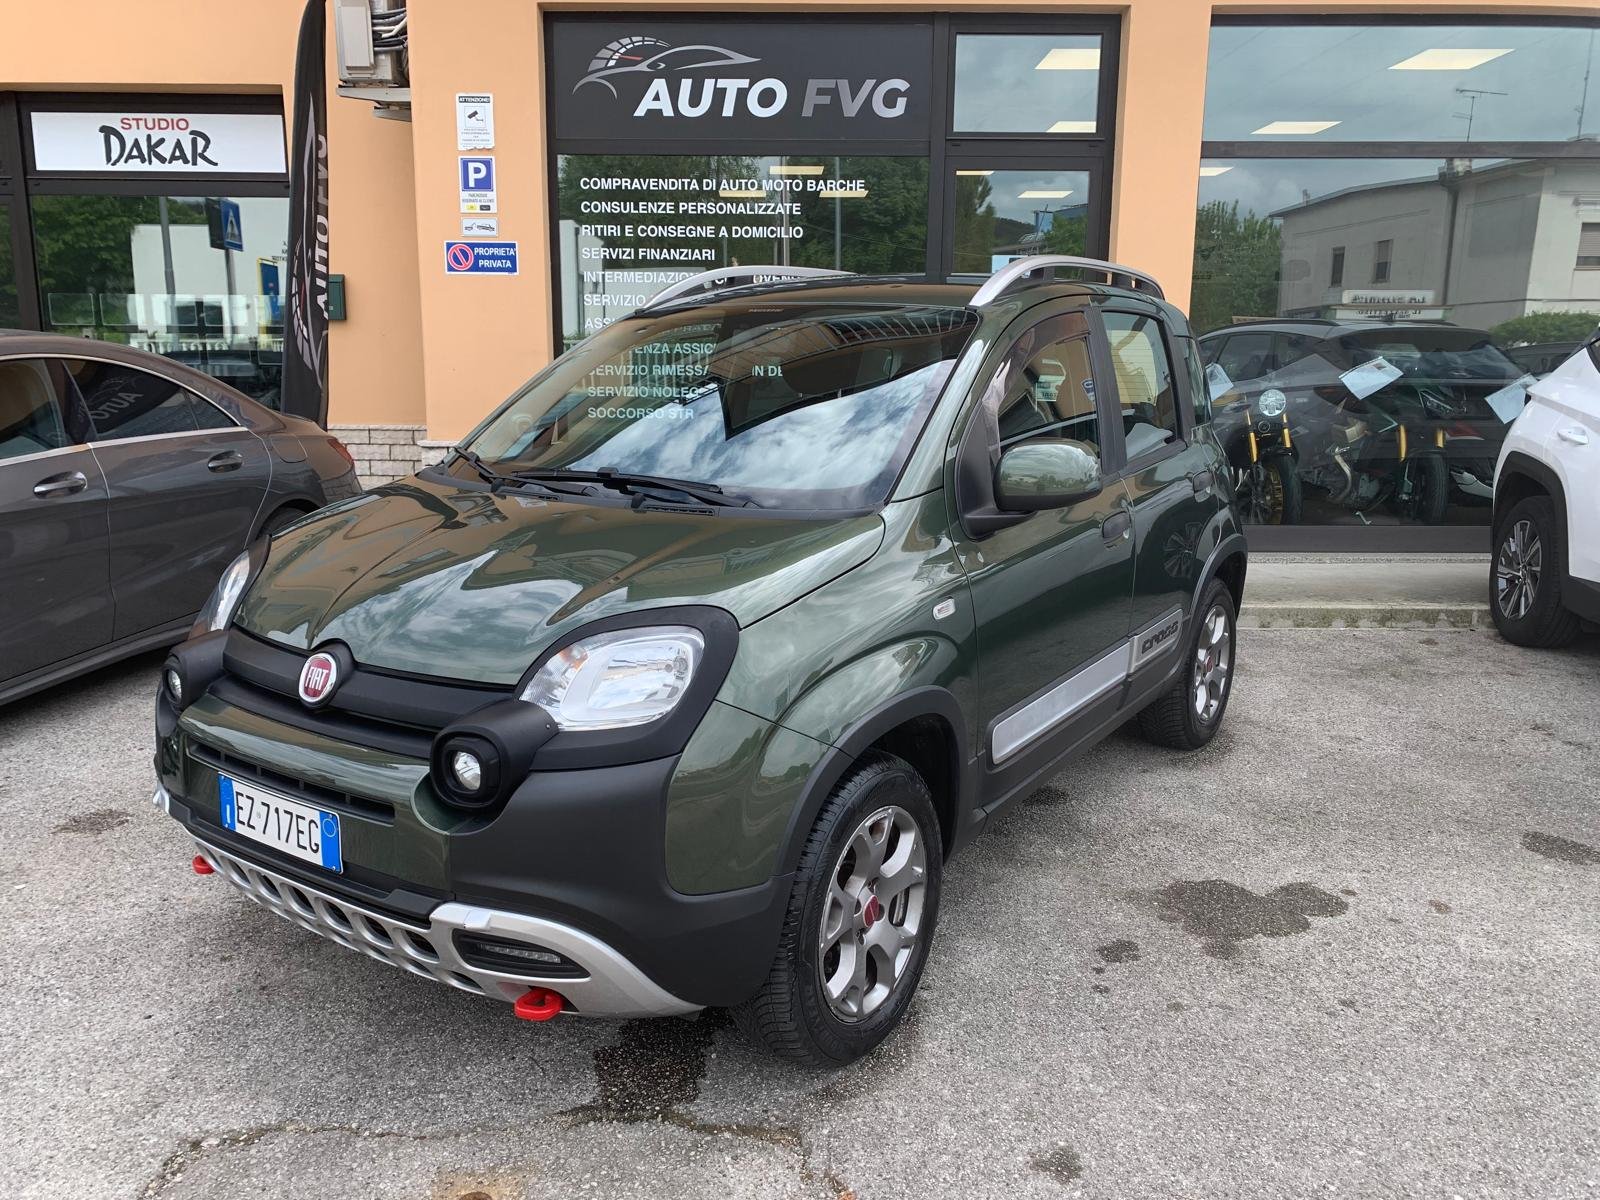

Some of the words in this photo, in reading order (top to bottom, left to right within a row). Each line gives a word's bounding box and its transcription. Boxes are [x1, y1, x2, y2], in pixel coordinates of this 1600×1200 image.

[633, 78, 788, 118] AUTO
[801, 78, 911, 118] FVG
[120, 117, 190, 130] STUDIO
[98, 125, 218, 166] DAKAR
[467, 161, 487, 188] P
[580, 178, 699, 190] COMPRAVENDITA
[703, 179, 716, 191] DI
[720, 179, 758, 191] AUTO
[763, 179, 803, 191] MOTO
[807, 180, 865, 192] BARCHE
[581, 201, 675, 213] CONSULENZE
[679, 202, 801, 214] PERSONALIZZATE
[581, 225, 620, 237] RITIRI
[625, 225, 633, 237] E
[638, 225, 715, 238] CONSEGNE
[719, 226, 728, 238] A
[732, 226, 803, 239] DOMICILIO
[582, 248, 635, 260] SERVIZI
[639, 248, 715, 260] FINANZIARI
[478, 259, 512, 268] PRIVATA
[583, 271, 698, 284] INTERMEDIAZIO
[583, 294, 646, 306] SERVIZIO
[673, 343, 717, 354] ASSIC
[588, 386, 648, 398] SERVIZIO
[588, 407, 664, 419] SOCCORSO
[305, 666, 329, 691] FIAT
[235, 790, 256, 830] EZ
[261, 801, 320, 854] 717EG
